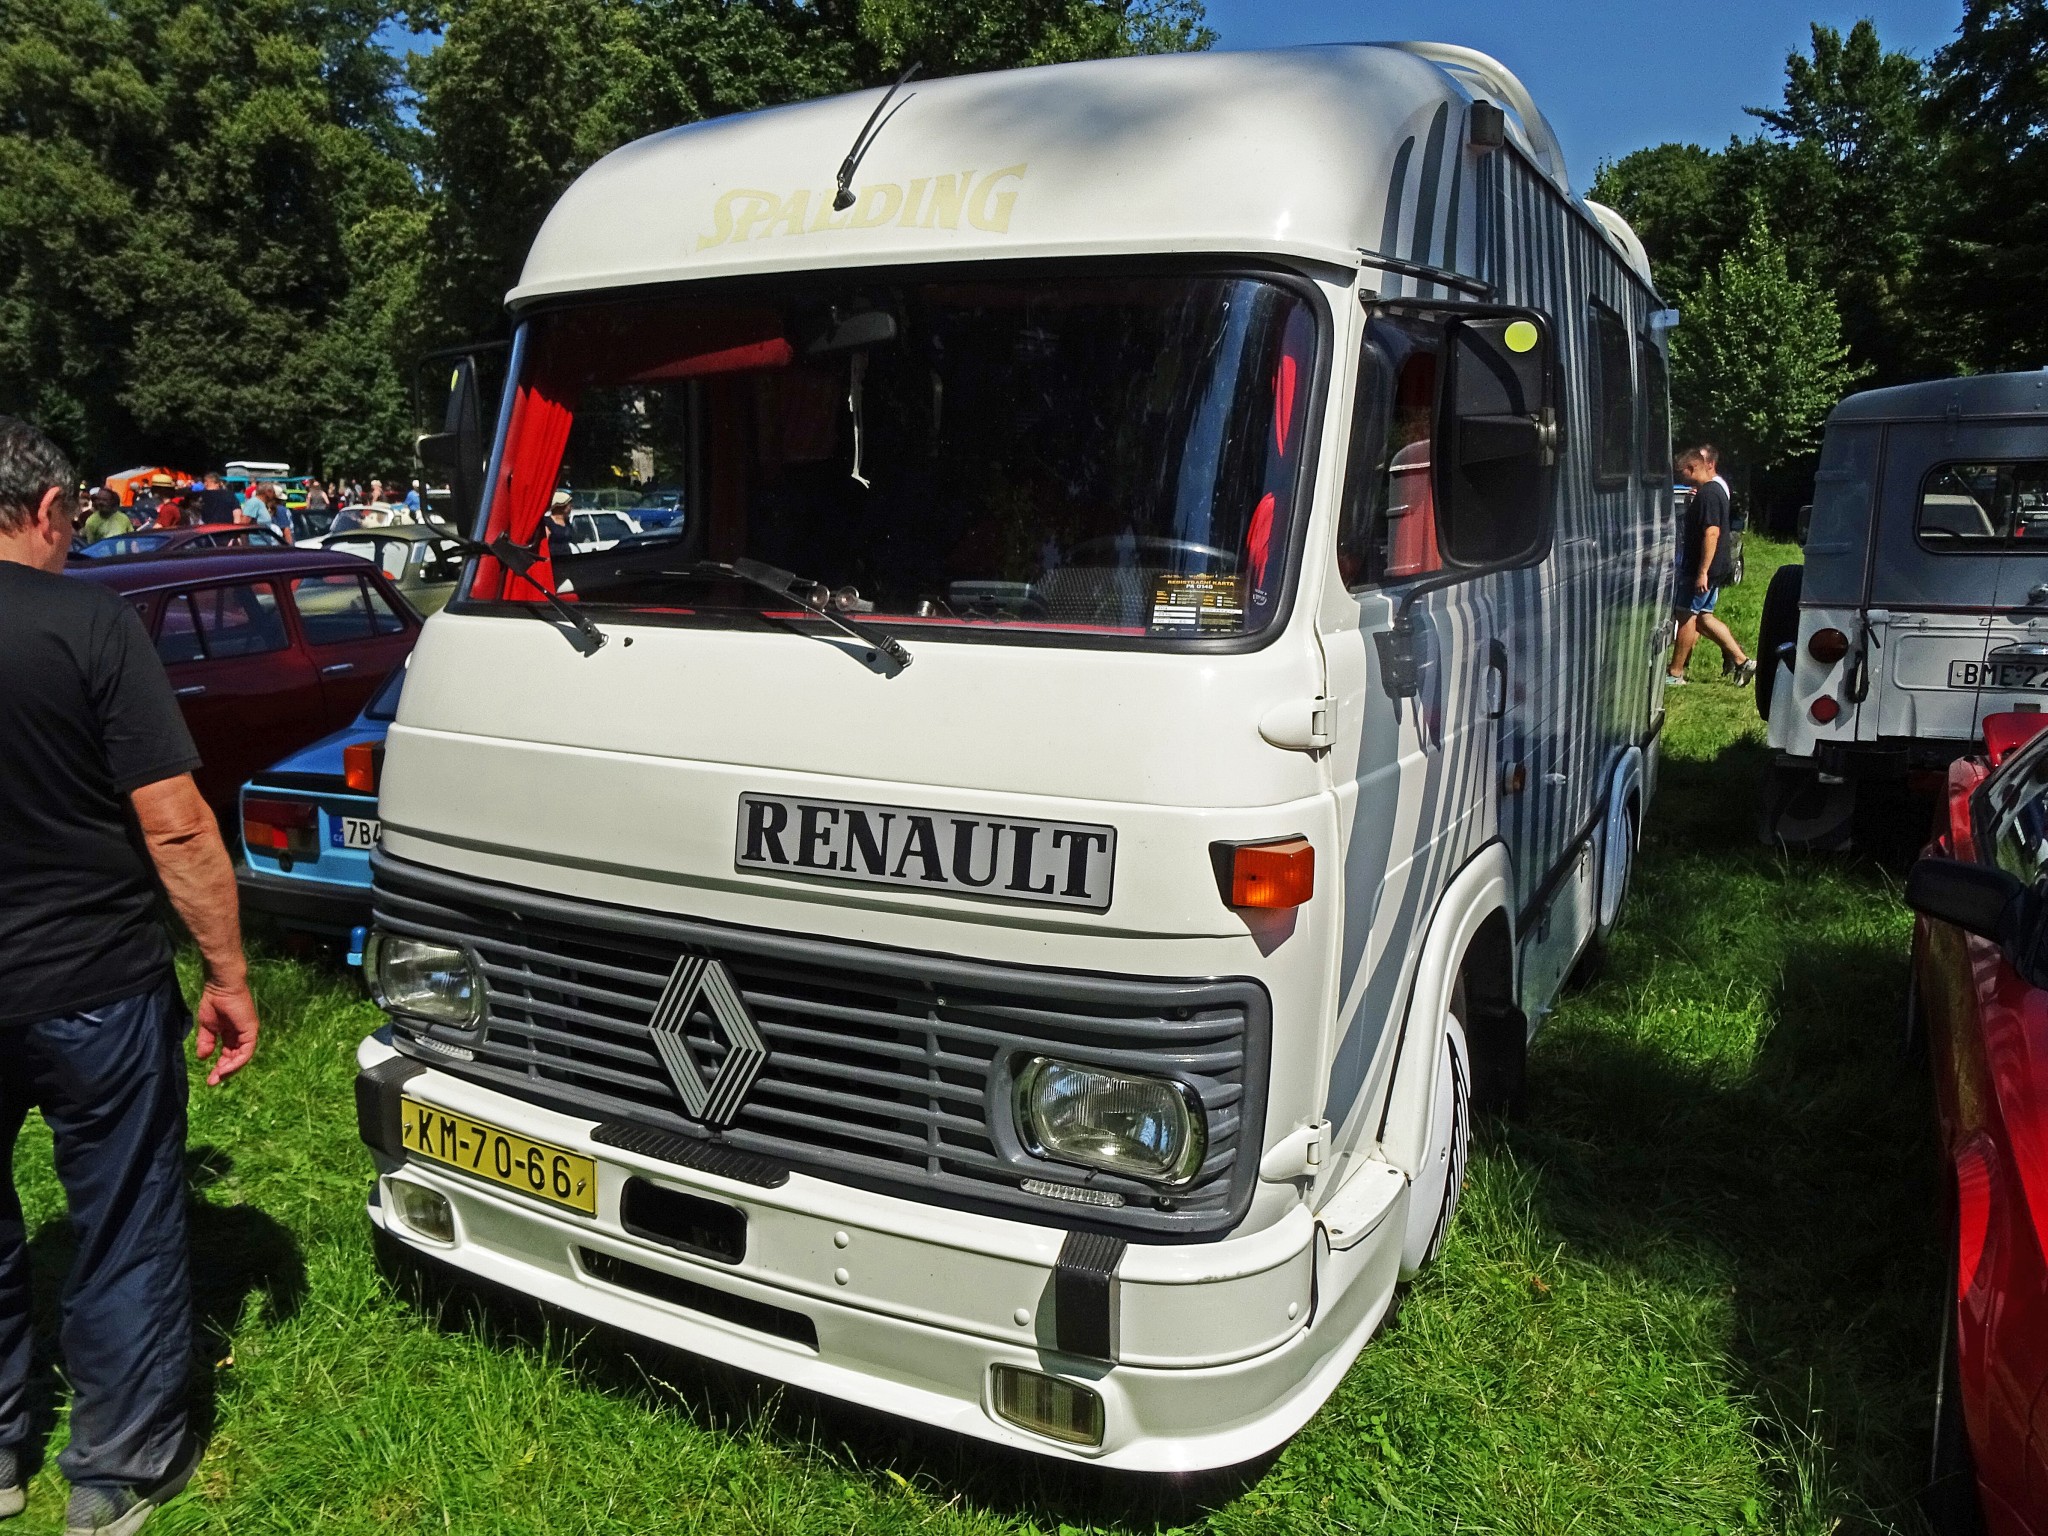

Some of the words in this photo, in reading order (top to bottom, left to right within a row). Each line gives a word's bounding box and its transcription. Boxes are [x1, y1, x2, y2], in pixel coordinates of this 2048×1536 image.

[696, 163, 1028, 252] SPALDING
[741, 800, 1106, 899] RENAULT
[418, 1109, 571, 1198] KM-70-66
